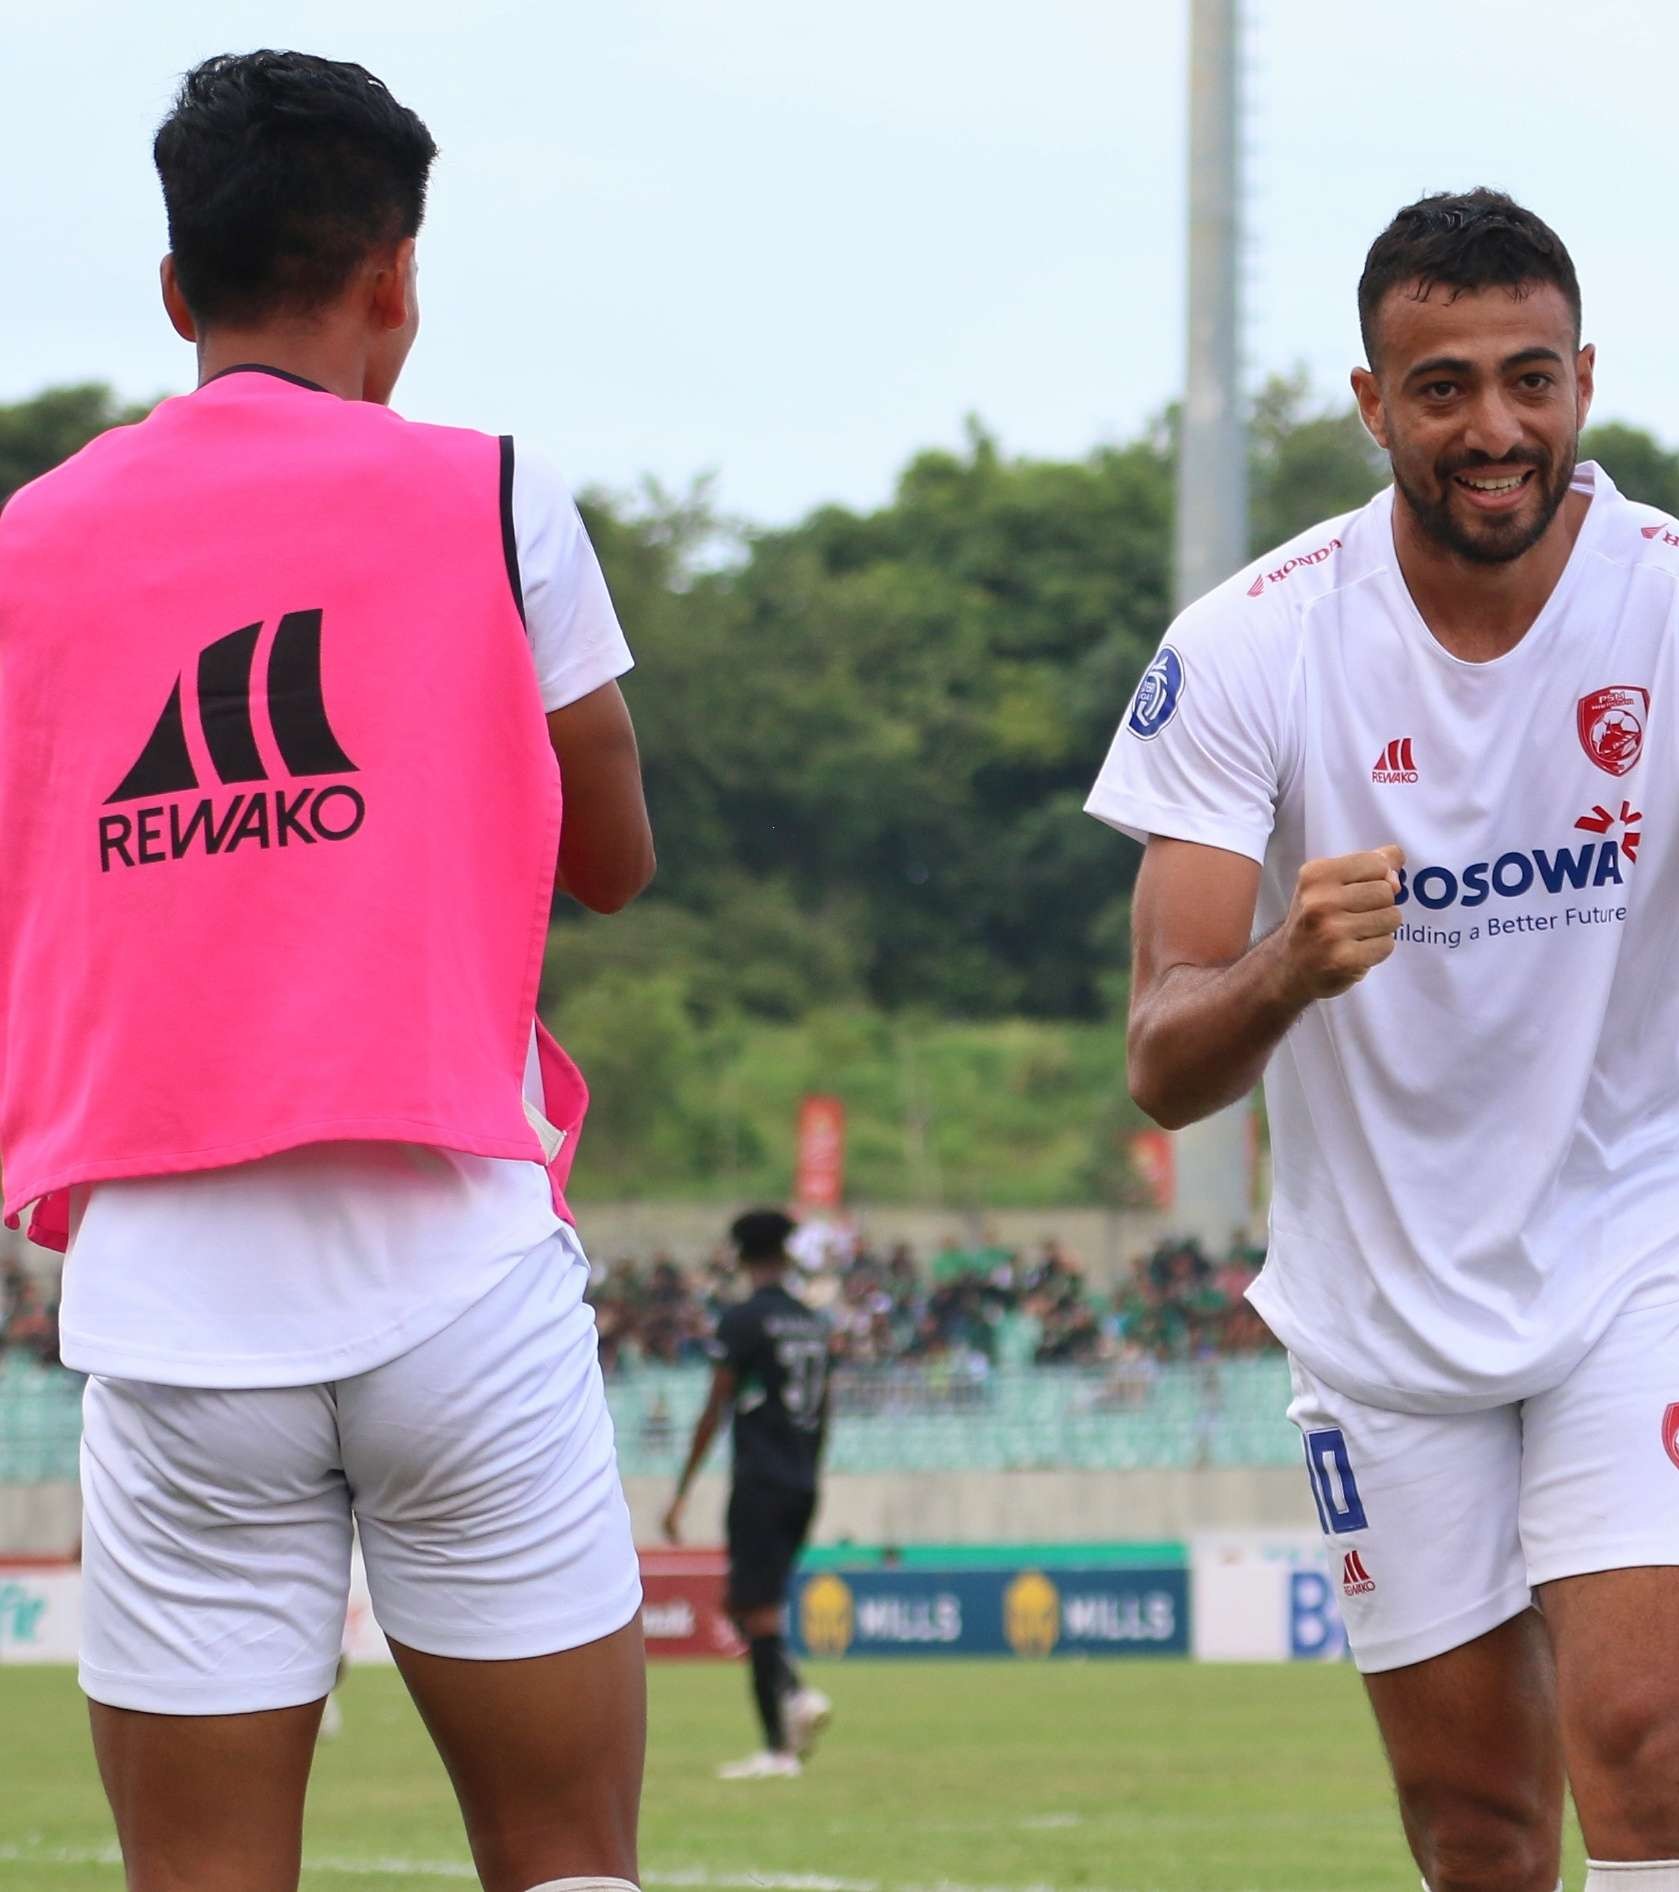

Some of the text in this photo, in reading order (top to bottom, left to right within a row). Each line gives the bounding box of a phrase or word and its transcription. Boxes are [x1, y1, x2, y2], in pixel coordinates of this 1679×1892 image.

[1266, 539, 1343, 583] HONDA
[1371, 771, 1419, 784] REWAKO
[98, 785, 366, 872] REWAKO
[1469, 926, 1481, 940] a
[1488, 914, 1558, 937] Better
[1566, 906, 1628, 927] Future
[859, 1594, 962, 1641] MILLS
[1065, 1592, 1176, 1641] MILLS
